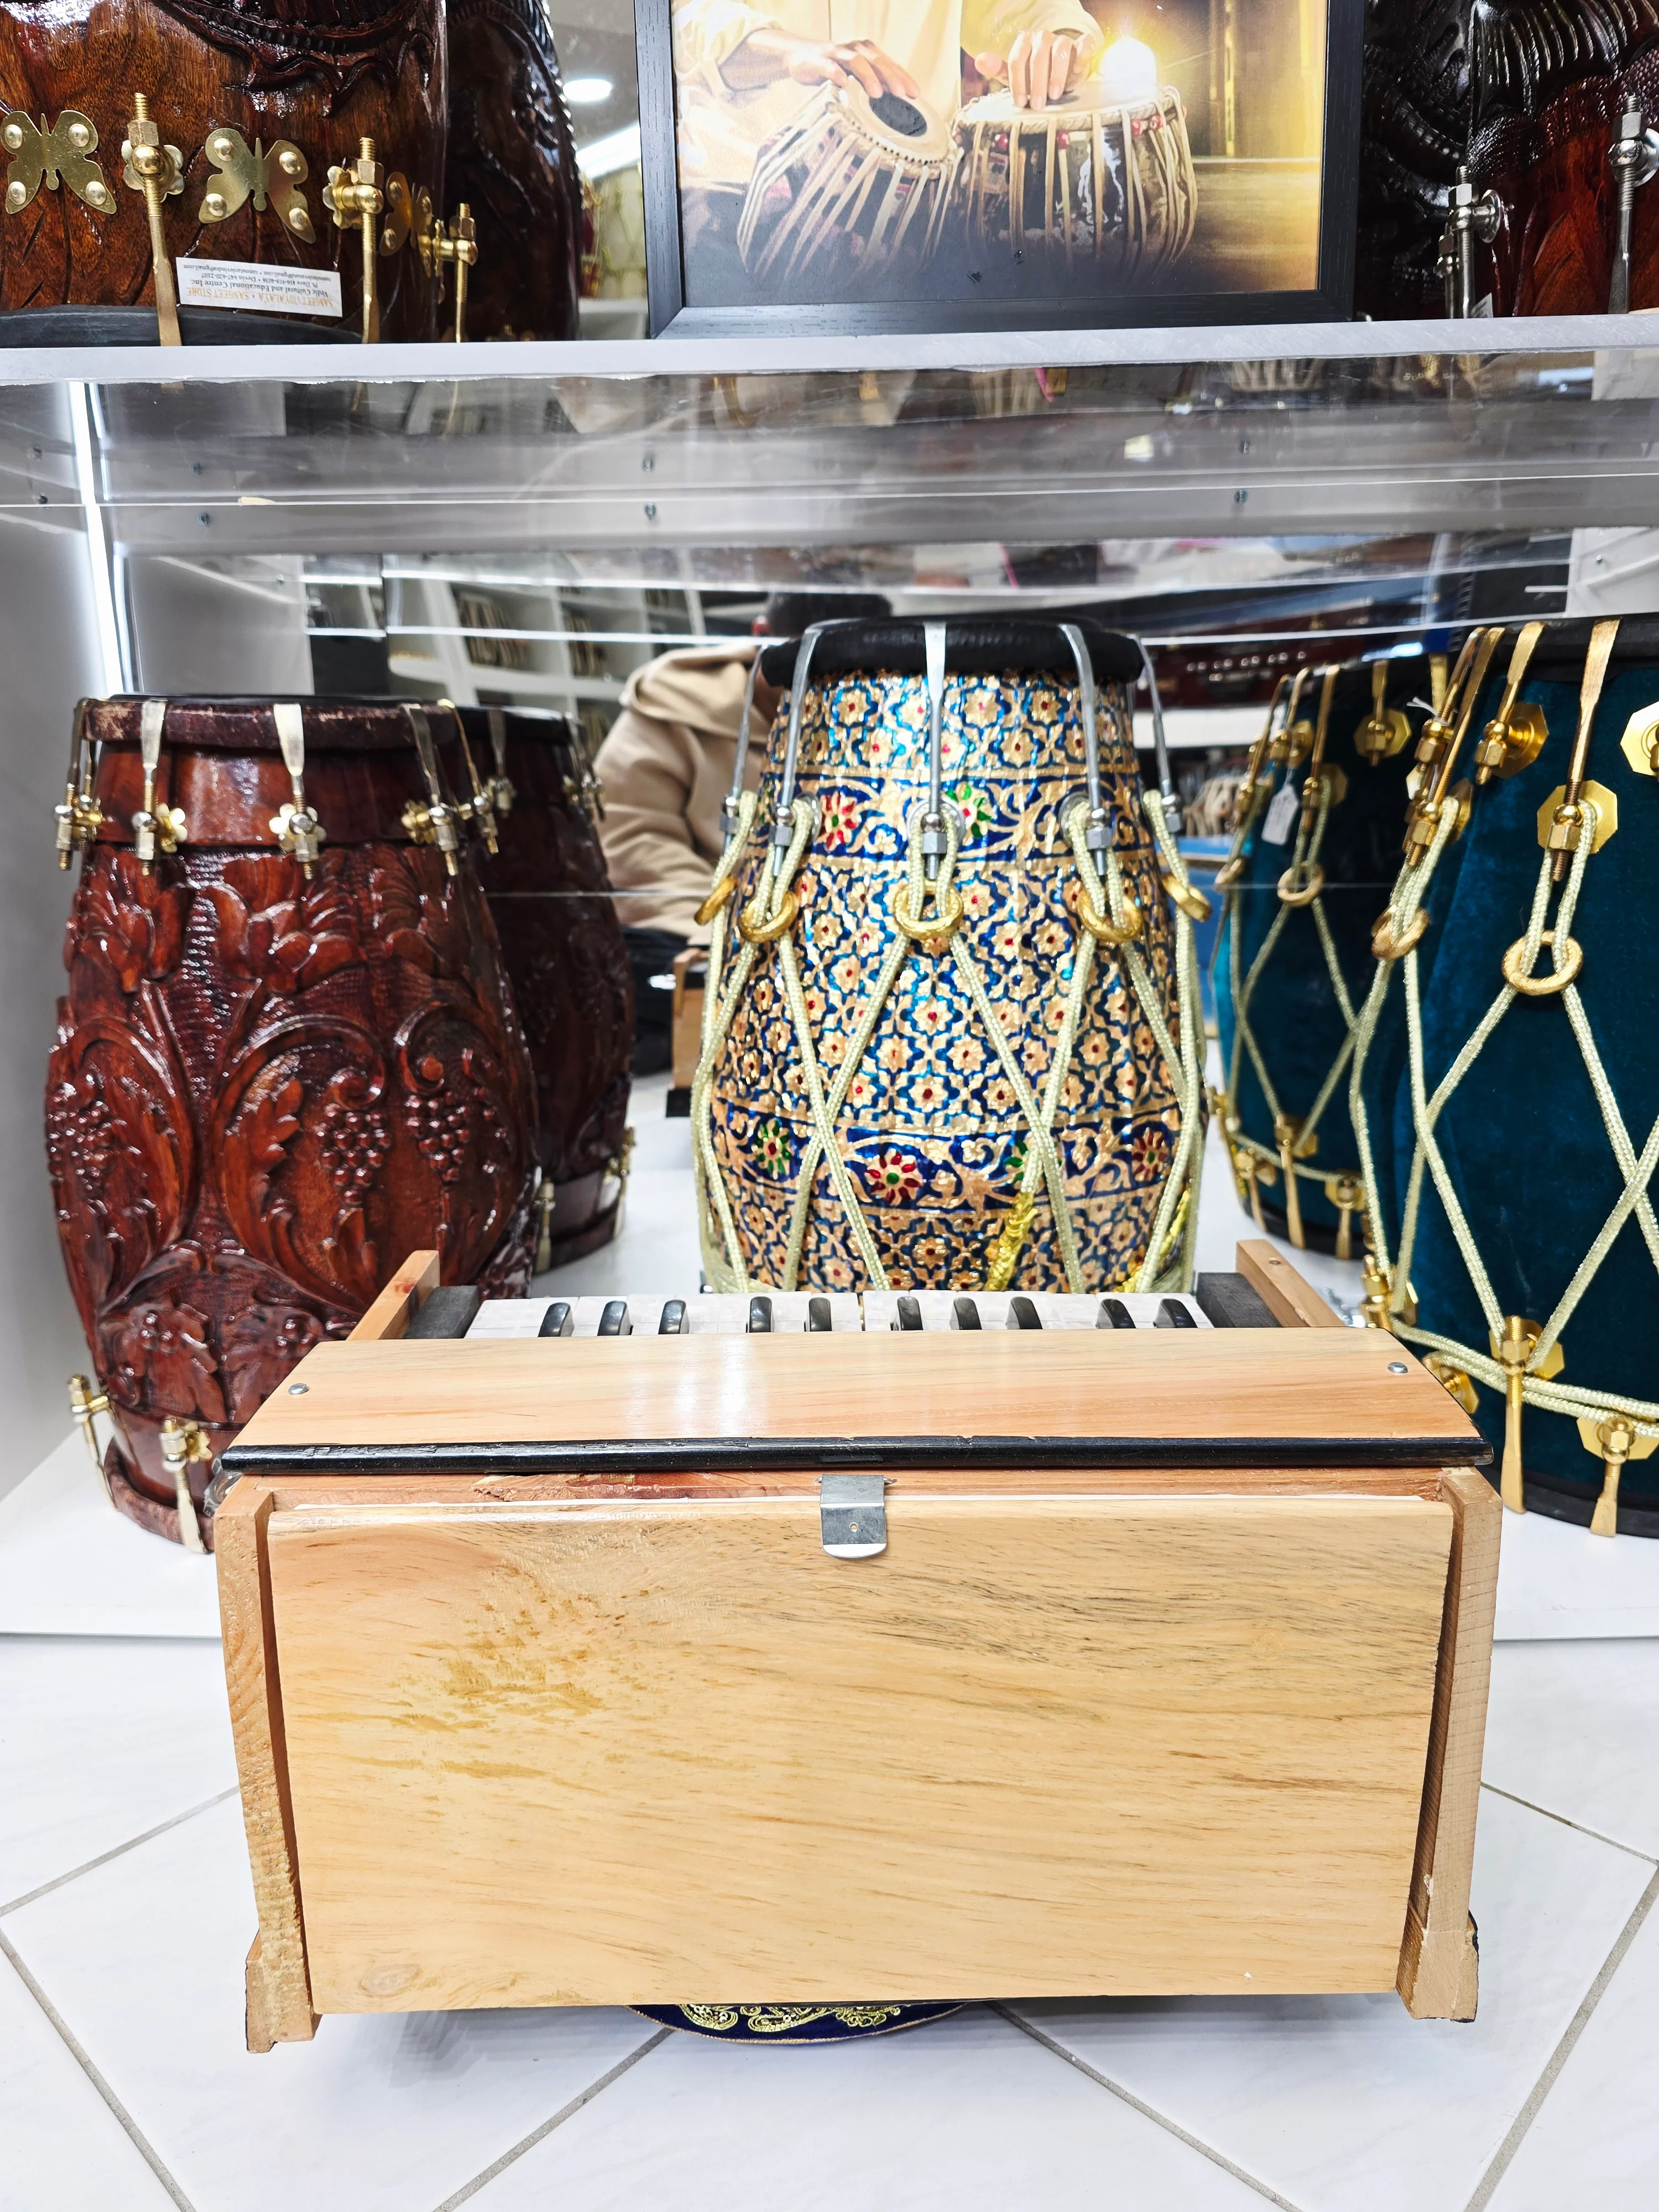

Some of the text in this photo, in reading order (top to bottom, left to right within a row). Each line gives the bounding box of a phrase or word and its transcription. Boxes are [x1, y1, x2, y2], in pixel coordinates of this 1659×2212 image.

[204, 280, 228, 289] Centre
[229, 282, 269, 292] Educational
[186, 286, 212, 298] STORE
[213, 289, 249, 301] SANGEET
[285, 286, 311, 296] Cultural
